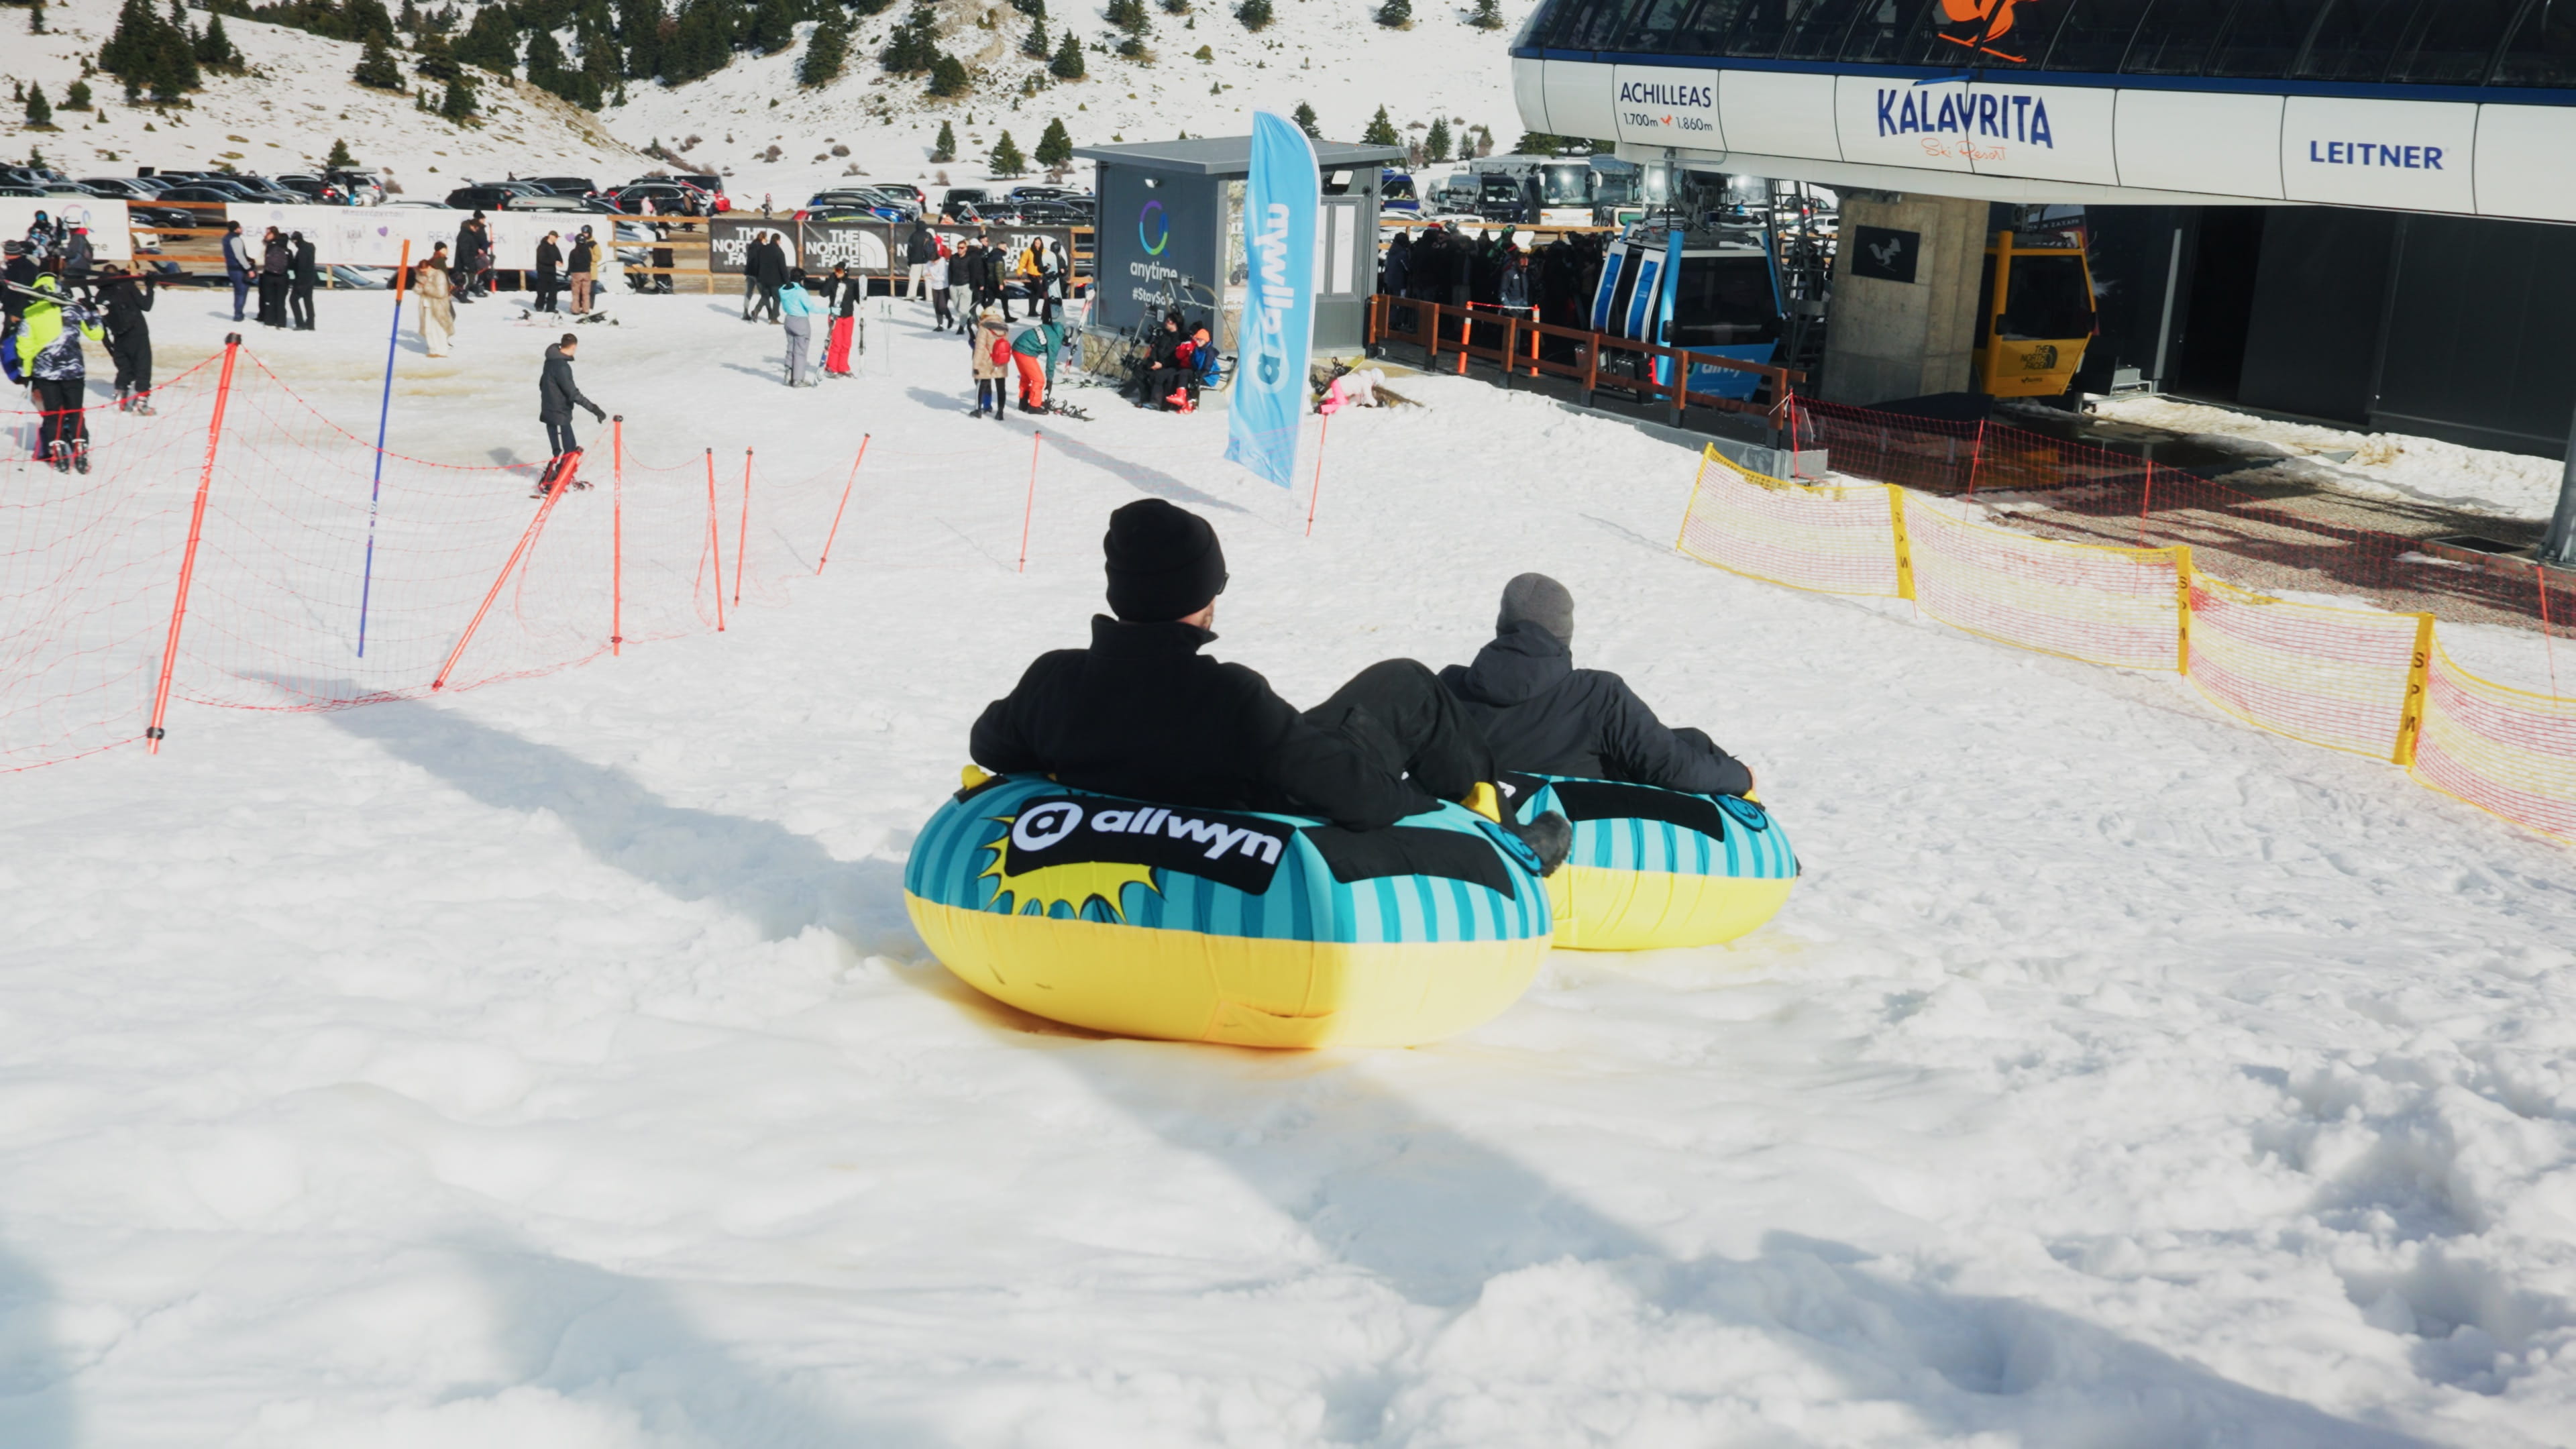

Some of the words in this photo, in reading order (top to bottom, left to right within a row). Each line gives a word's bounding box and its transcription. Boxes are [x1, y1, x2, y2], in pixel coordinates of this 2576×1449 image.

[1620, 82, 1711, 108] ACHILLEAS
[1623, 113, 1658, 127] 1.700m
[1676, 117, 1713, 131] 1.860m
[1878, 89, 2053, 150] KALAVRITA
[1921, 138, 1951, 156] Ski
[1955, 140, 2007, 161] Resort
[2310, 140, 2444, 170] LEITNER
[828, 229, 859, 242] THE
[806, 241, 859, 255] NORTH
[1130, 261, 1178, 282] anytime
[1091, 807, 1283, 865] allwyn
